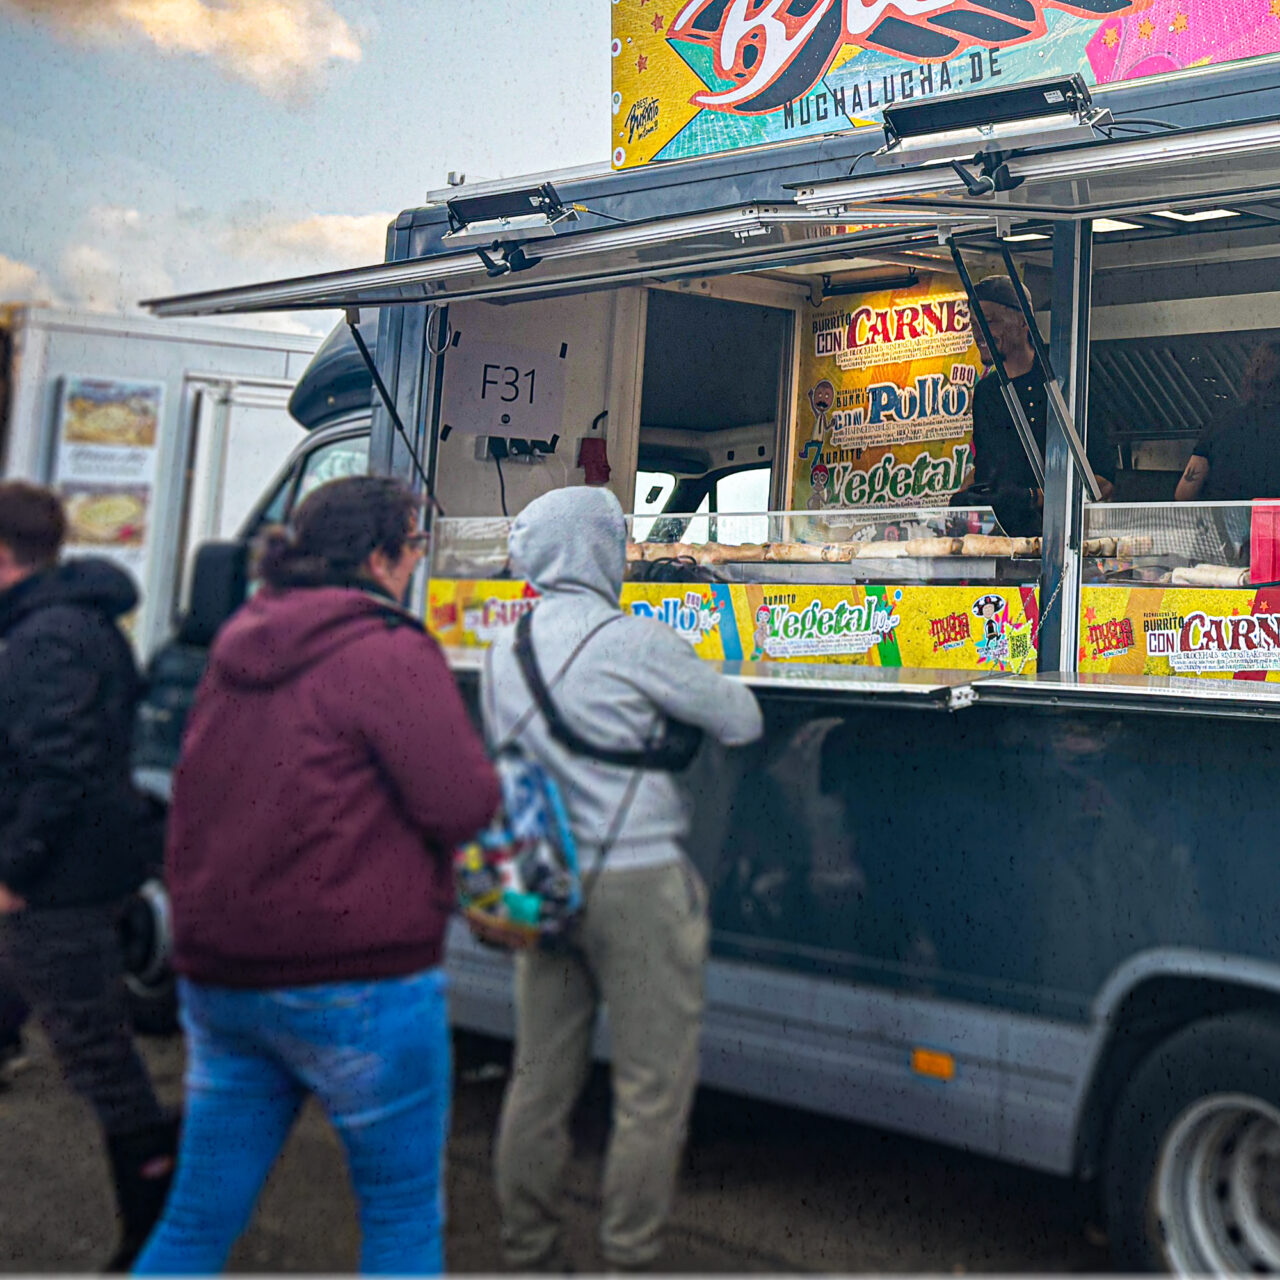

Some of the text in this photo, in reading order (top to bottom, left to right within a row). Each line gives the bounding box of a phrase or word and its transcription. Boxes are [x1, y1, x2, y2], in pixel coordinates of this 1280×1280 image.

[784, 47, 1001, 129] MUCHALUCHA.DE
[812, 313, 850, 334] BURRITO
[816, 331, 842, 355] CON
[847, 300, 971, 350] CARNE
[481, 364, 536, 404] F31
[952, 366, 974, 386] BBQ
[868, 378, 967, 424] Pollo
[827, 448, 968, 504] Vegetal
[769, 599, 876, 639] Vegetal
[1144, 616, 1184, 632] BURRITO
[1149, 633, 1175, 653] CON
